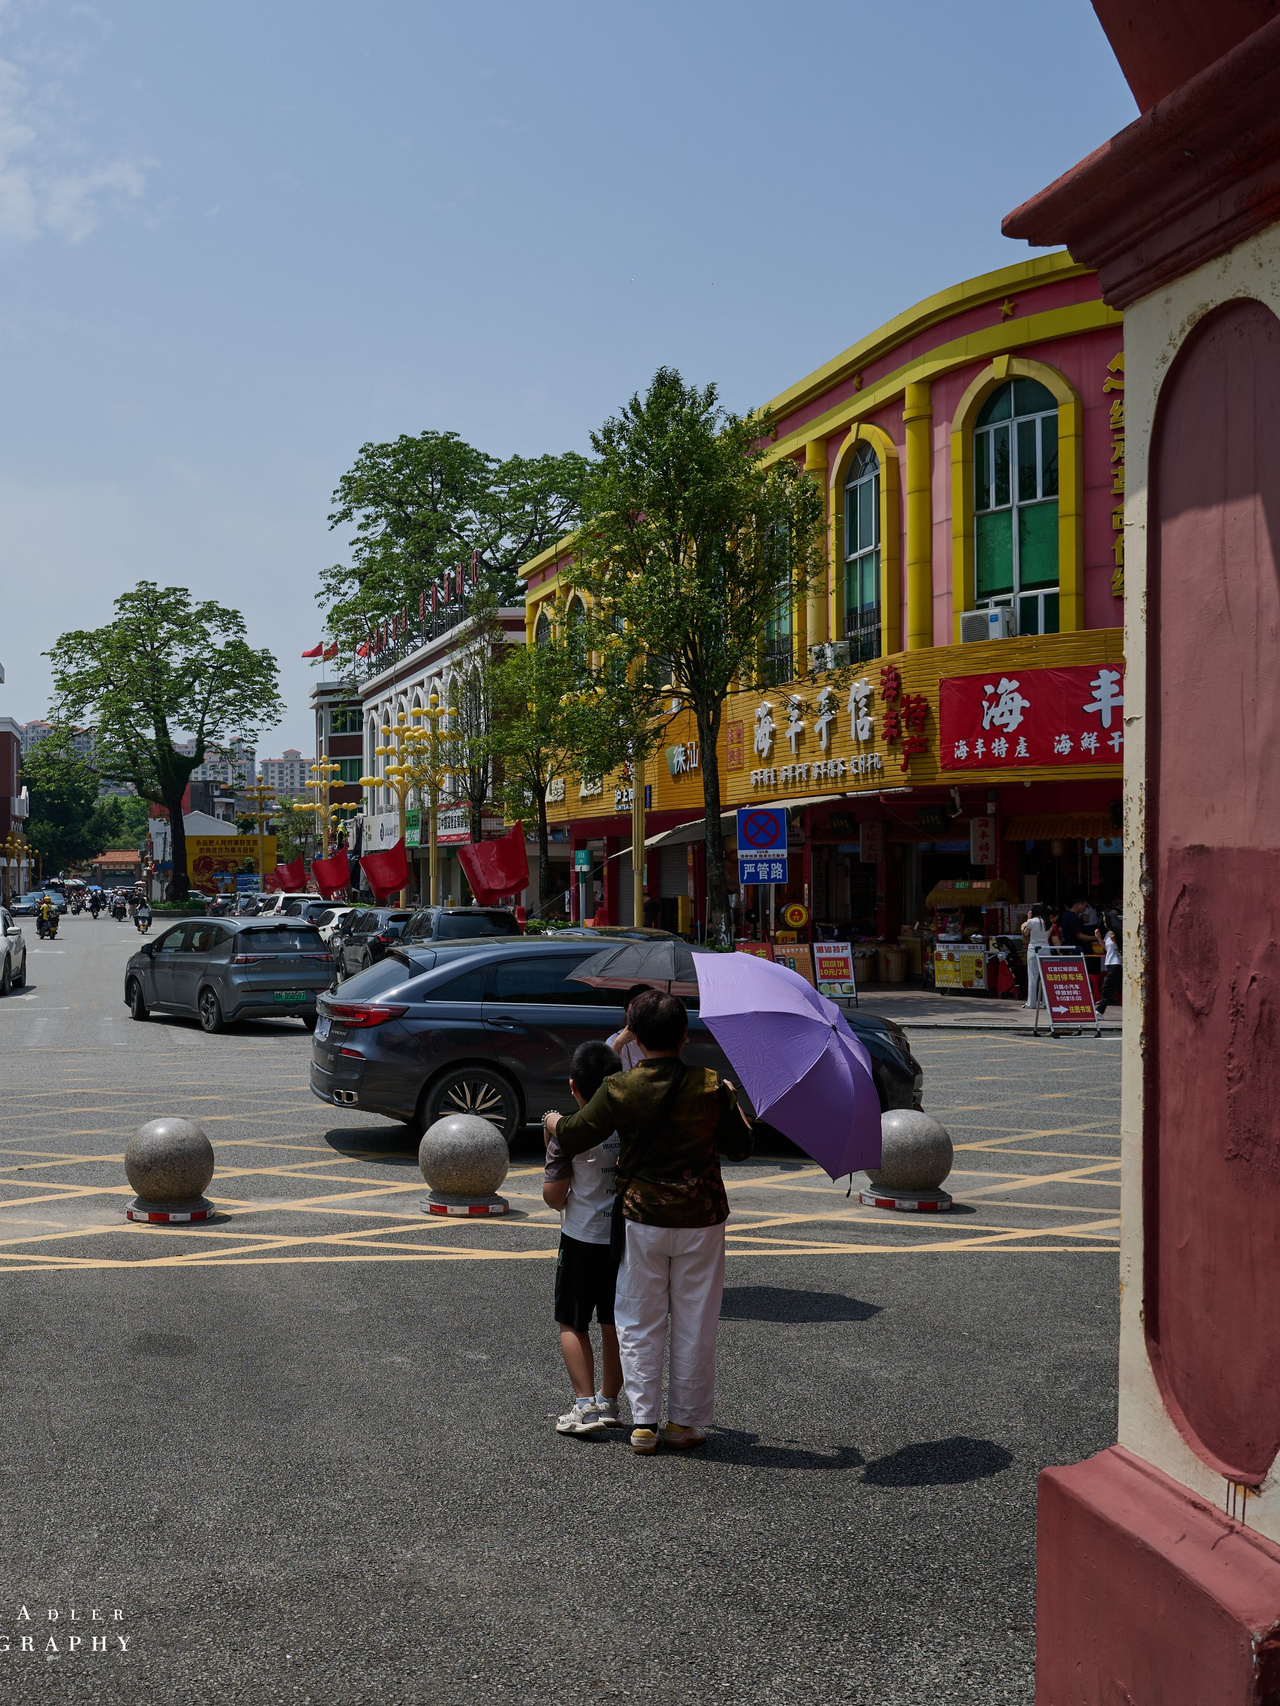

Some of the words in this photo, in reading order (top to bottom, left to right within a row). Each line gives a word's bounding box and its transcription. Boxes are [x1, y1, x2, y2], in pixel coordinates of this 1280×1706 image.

[754, 677, 874, 758] 海丰手信
[982, 677, 1030, 733] 海
[1082, 669, 1124, 729] 丰
[900, 694, 929, 773] 特产
[743, 863, 784, 880] 严管路
[1046, 973, 1083, 981] 临时停车场
